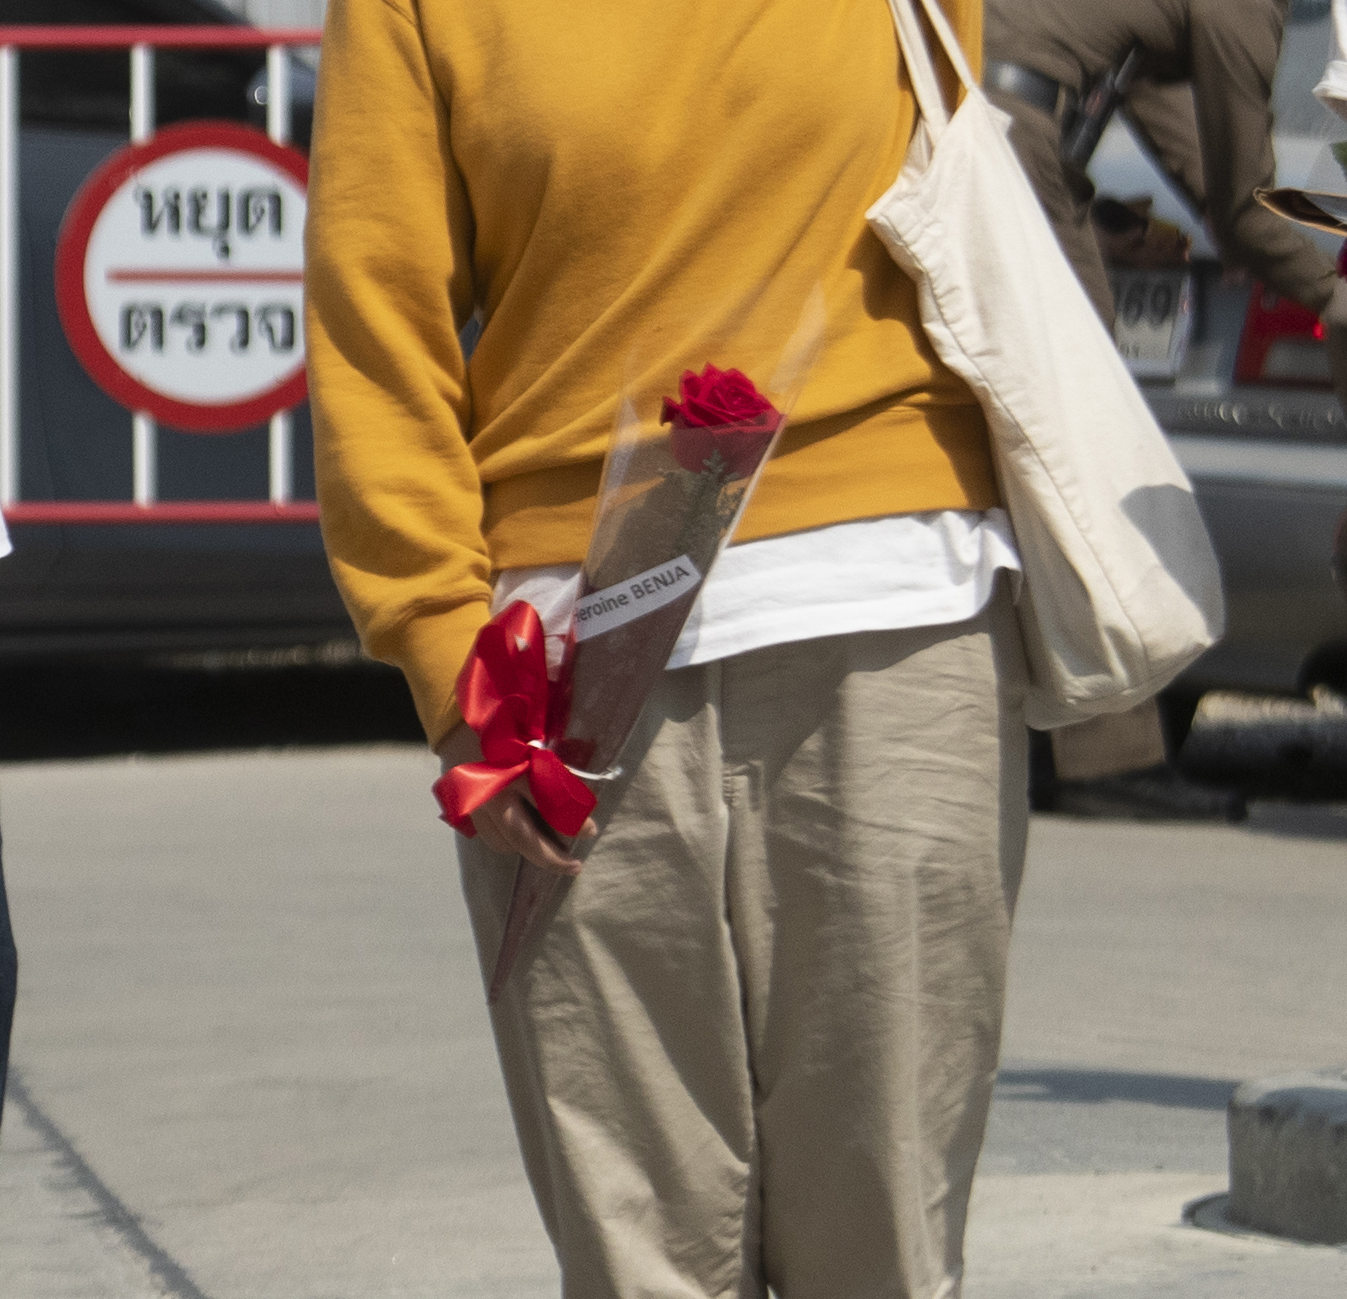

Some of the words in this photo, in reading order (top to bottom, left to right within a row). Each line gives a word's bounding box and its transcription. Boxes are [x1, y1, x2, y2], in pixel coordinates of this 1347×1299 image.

[135, 185, 282, 260] หยุด
[119, 301, 295, 353] ตรวจ
[630, 565, 690, 599] BENJA
